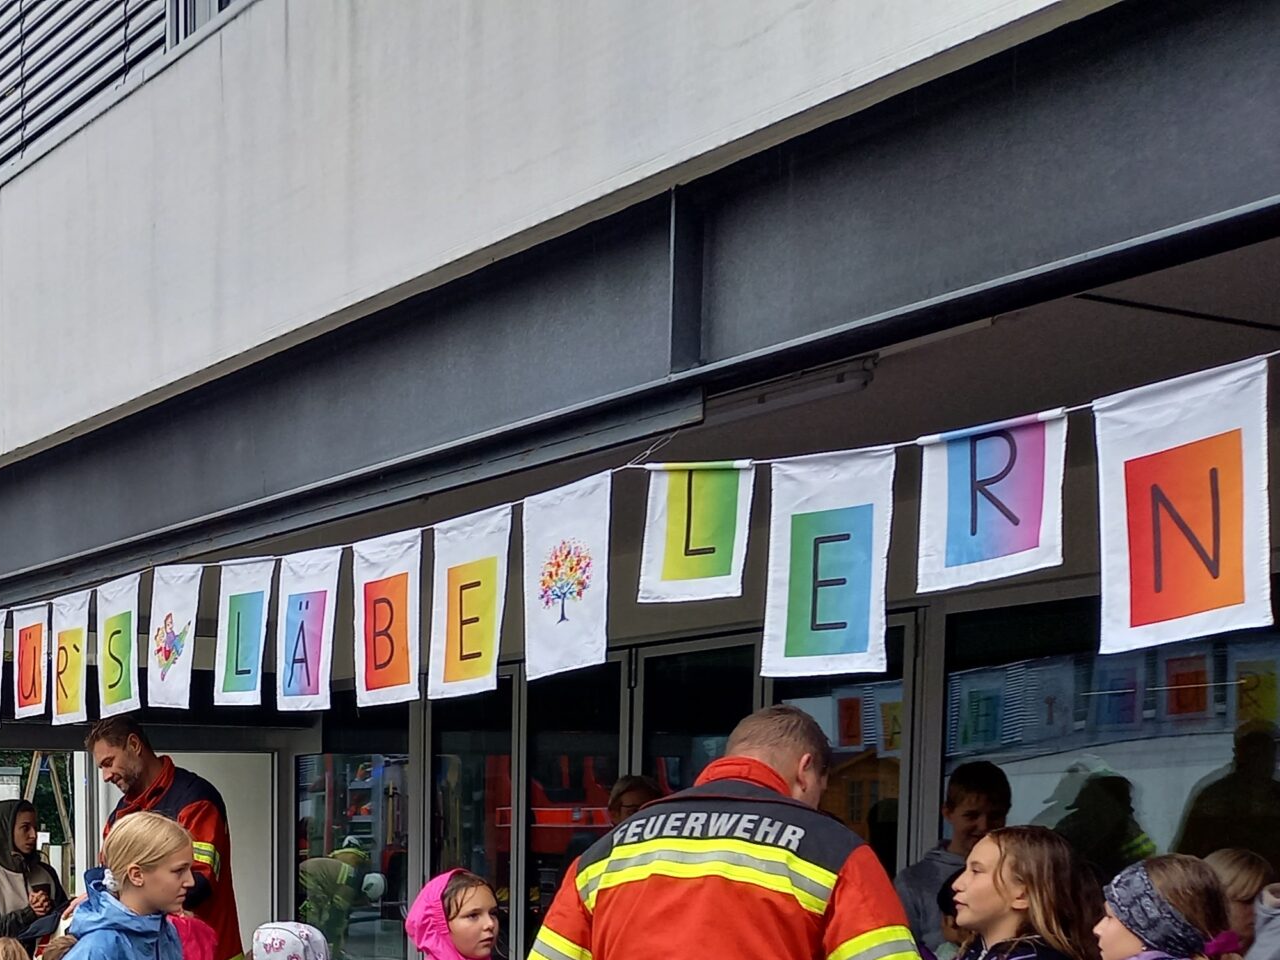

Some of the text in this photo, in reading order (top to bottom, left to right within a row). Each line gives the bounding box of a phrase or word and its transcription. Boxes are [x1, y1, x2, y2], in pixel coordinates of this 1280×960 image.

[234, 580, 483, 688] LÄBE
[684, 429, 1221, 631] LERN
[613, 811, 806, 851] FEUERWEHR
